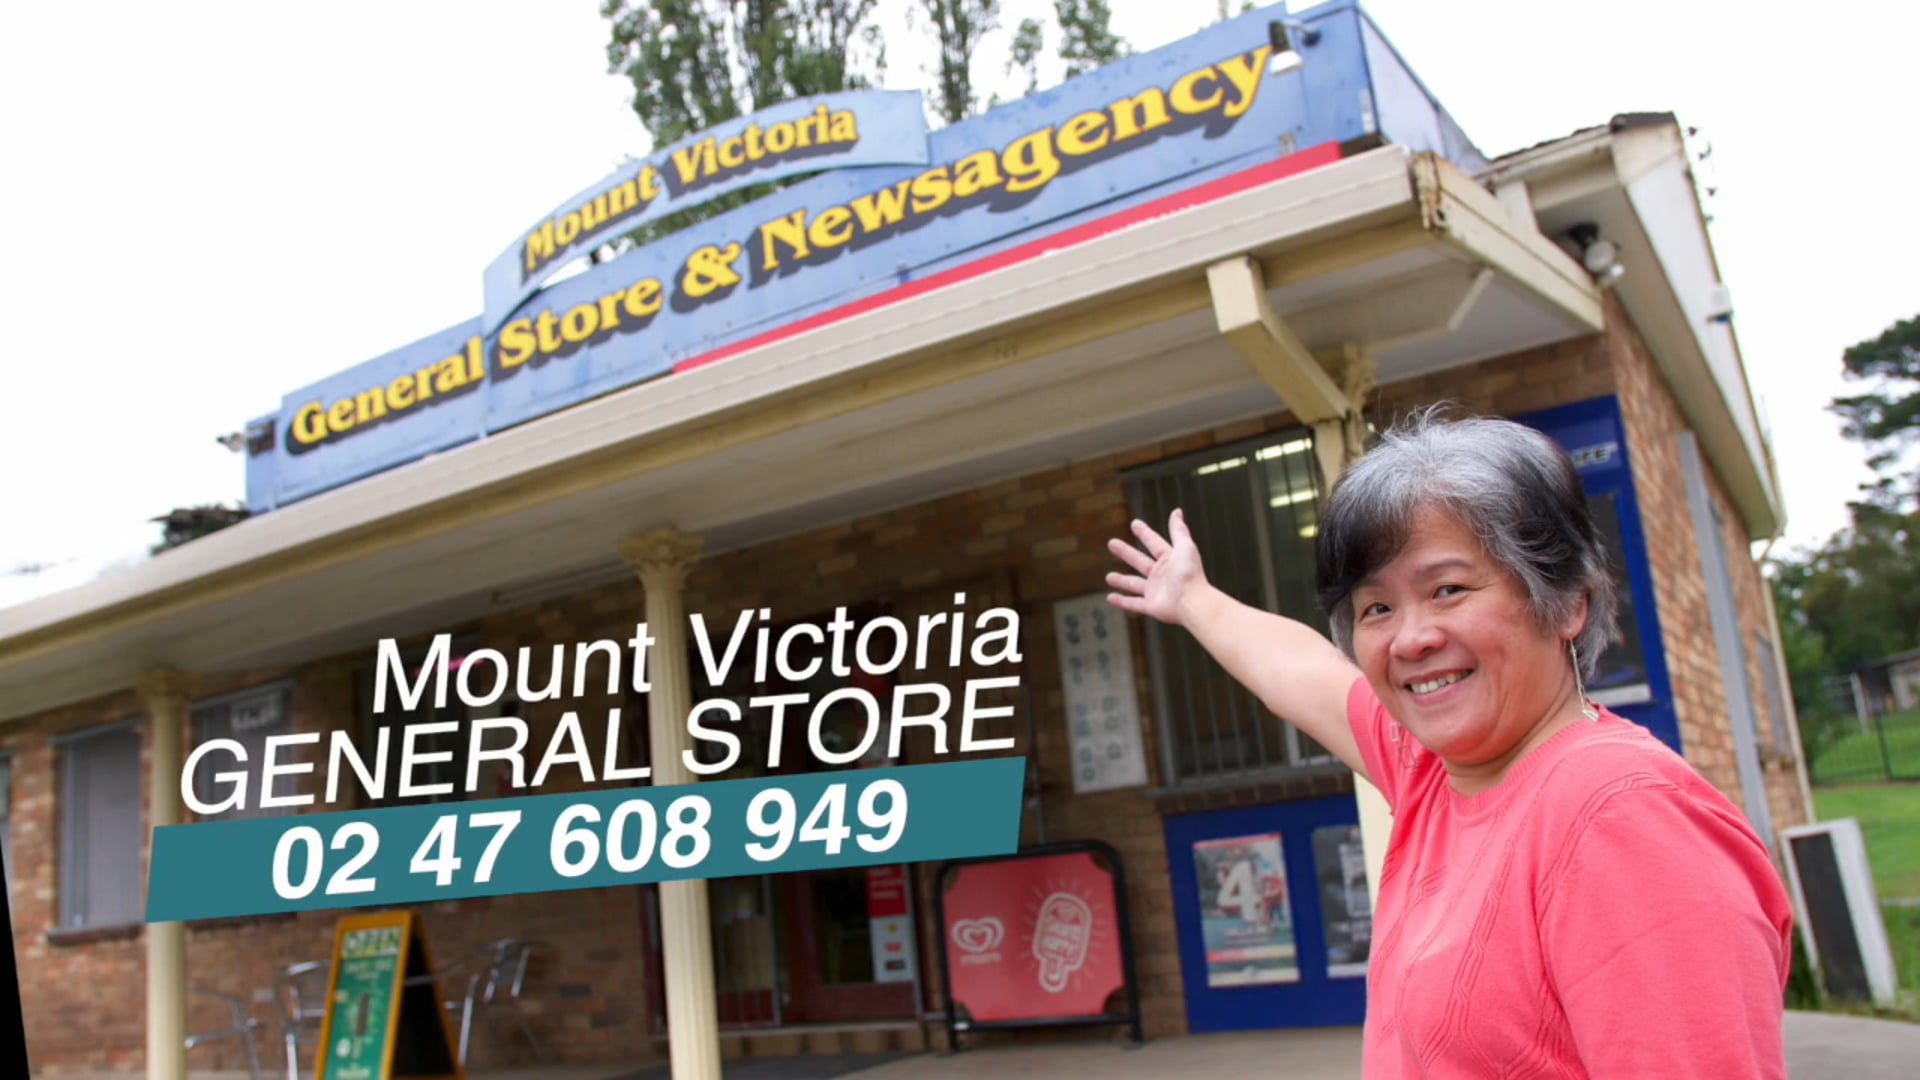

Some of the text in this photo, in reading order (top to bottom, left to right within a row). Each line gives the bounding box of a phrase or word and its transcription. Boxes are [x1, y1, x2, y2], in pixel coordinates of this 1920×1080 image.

[292, 44, 1273, 445] General Store & Newsagency
[522, 104, 859, 271] Mount Victoria
[1217, 860, 1262, 924] 4
